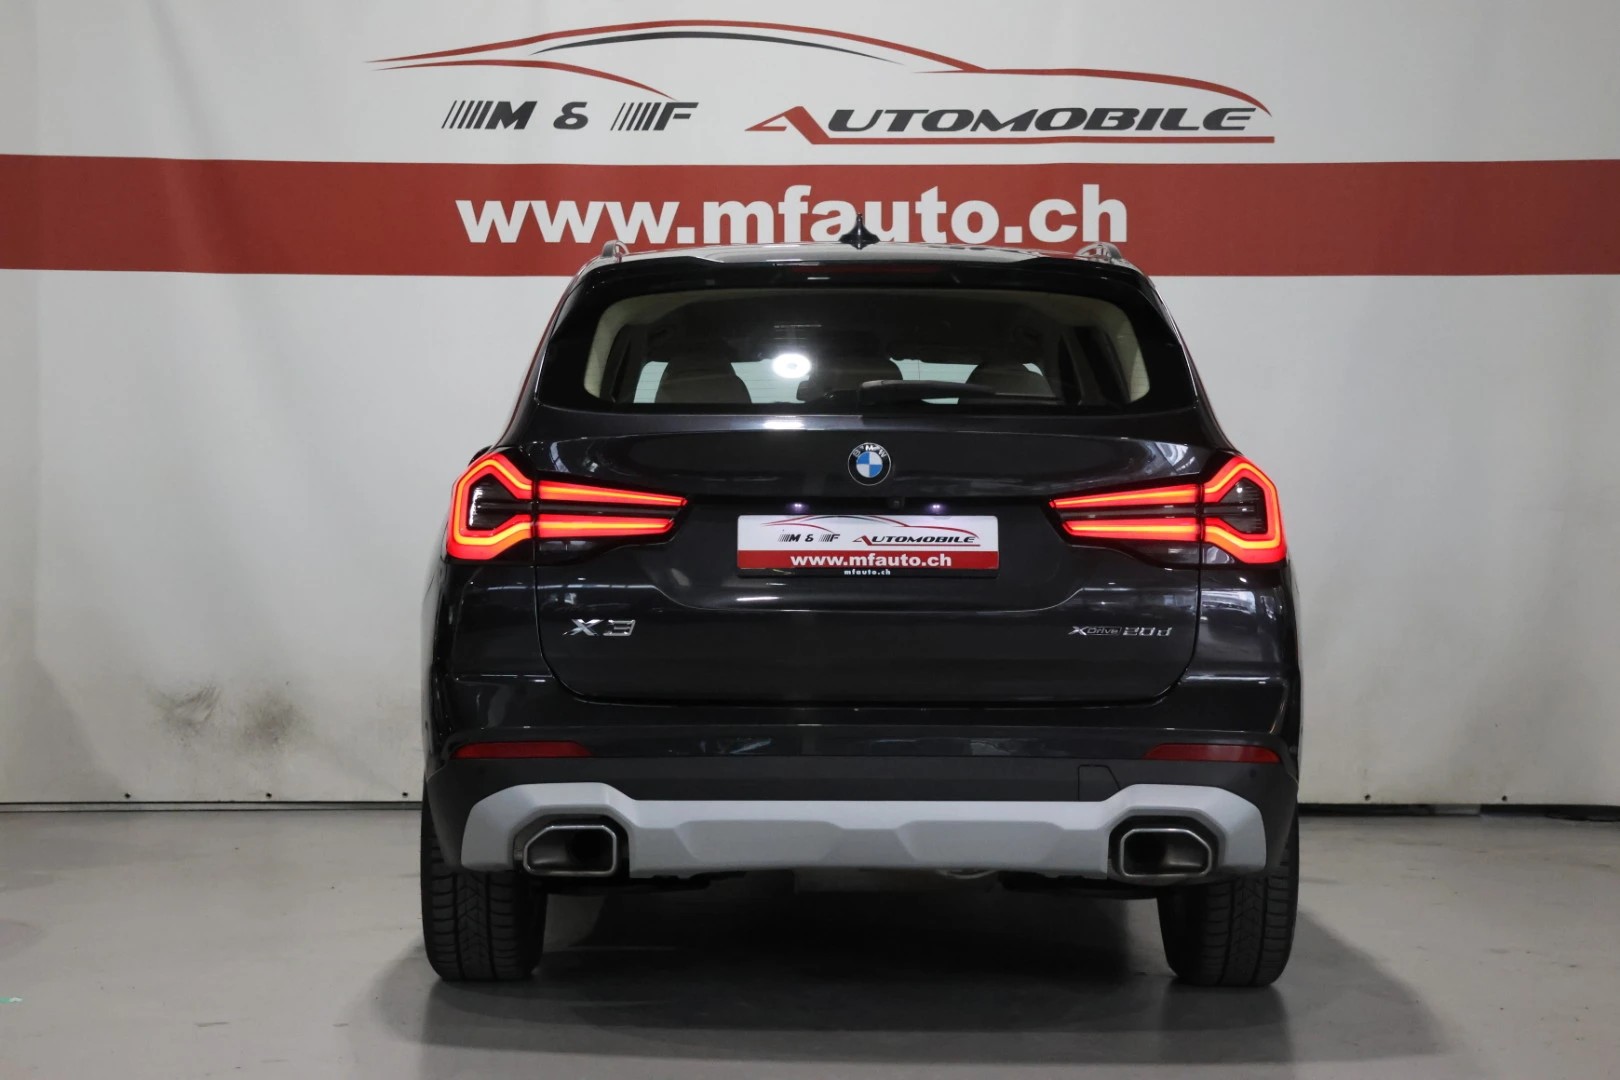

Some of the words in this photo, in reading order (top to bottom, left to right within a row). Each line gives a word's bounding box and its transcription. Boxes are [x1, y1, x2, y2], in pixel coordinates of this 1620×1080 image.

[553, 101, 588, 130] &
[455, 184, 1128, 244] www.mfauto.ch
[852, 444, 887, 458] BMW
[790, 553, 952, 566] www.mfauto.ch
[563, 619, 636, 636] X3
